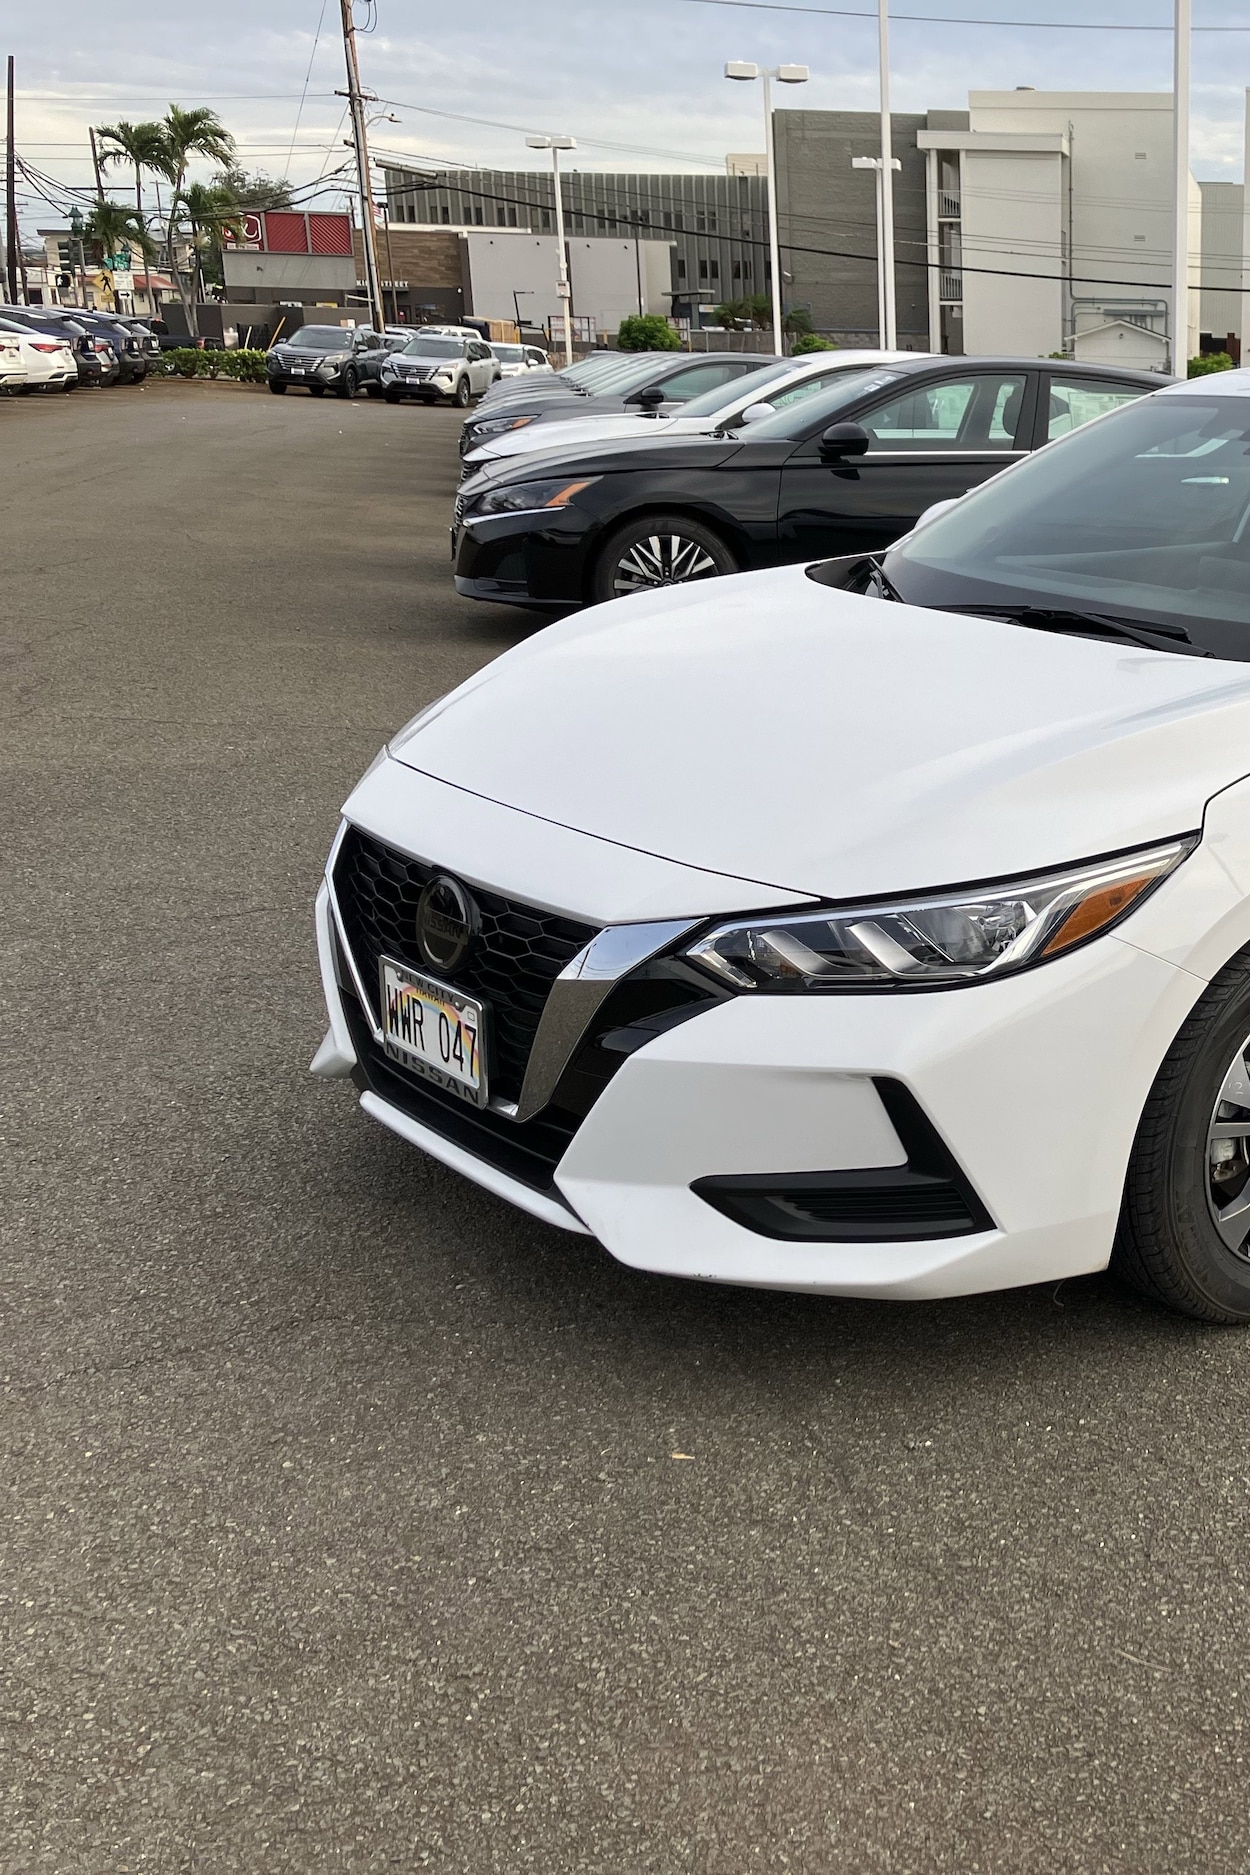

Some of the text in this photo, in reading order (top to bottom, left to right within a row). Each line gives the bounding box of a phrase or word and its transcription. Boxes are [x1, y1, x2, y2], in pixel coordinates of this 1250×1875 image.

[416, 988, 445, 1006] HAWAII
[428, 983, 454, 1002] CITY
[387, 984, 477, 1078] WWR 047
[386, 1042, 479, 1105] NISSAN
